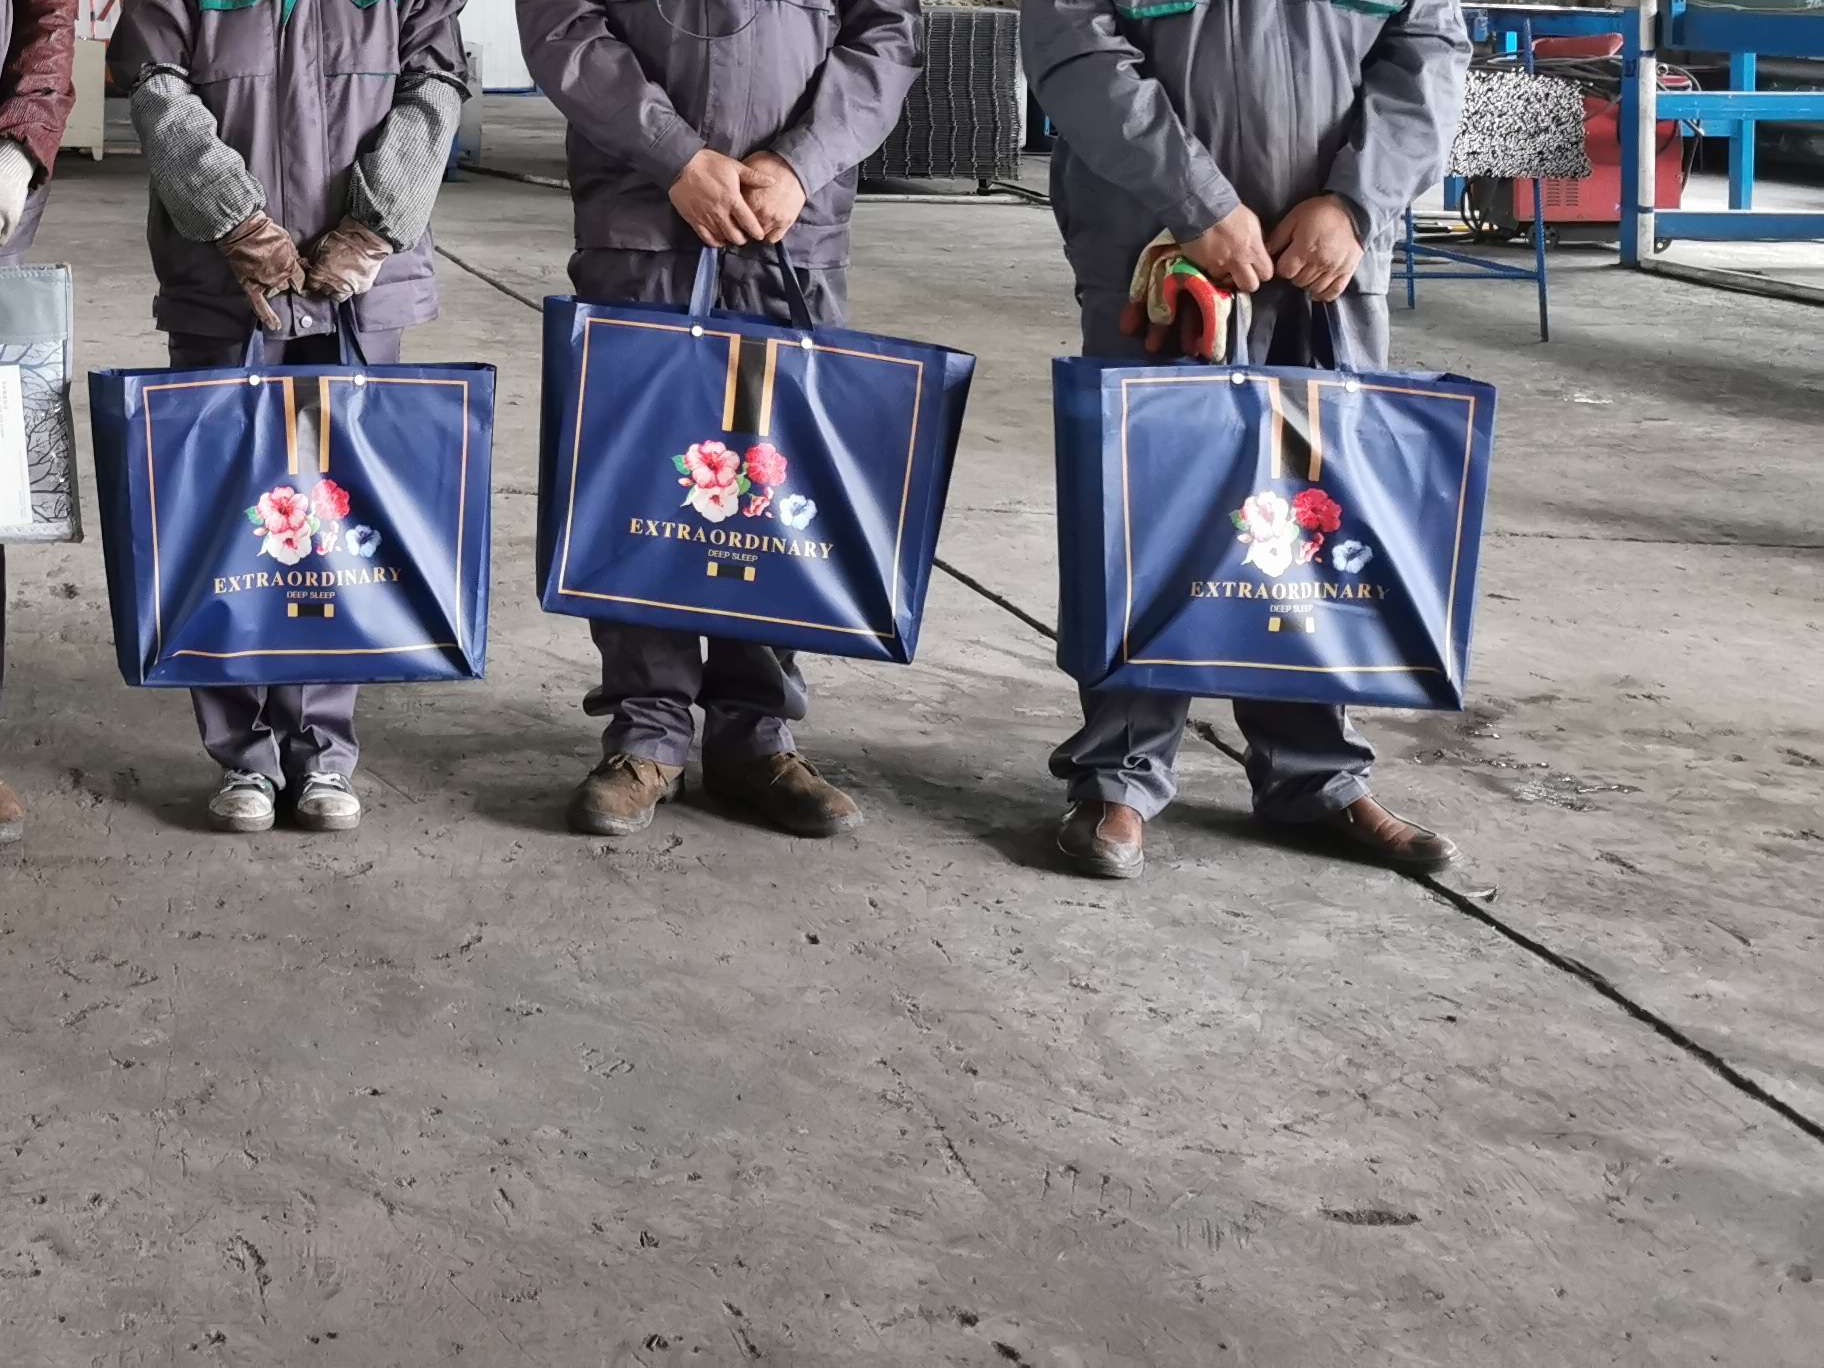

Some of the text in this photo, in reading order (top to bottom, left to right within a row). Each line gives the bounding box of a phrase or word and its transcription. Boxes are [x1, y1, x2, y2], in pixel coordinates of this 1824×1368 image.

[628, 517, 835, 559] EXTRAORDINARY
[707, 548, 759, 562] DEEP SLEEP
[213, 566, 402, 595] EXTRAORDINARY
[286, 591, 336, 600] DEEP SLEEP
[1189, 581, 1391, 600] EXTRAORDINARY
